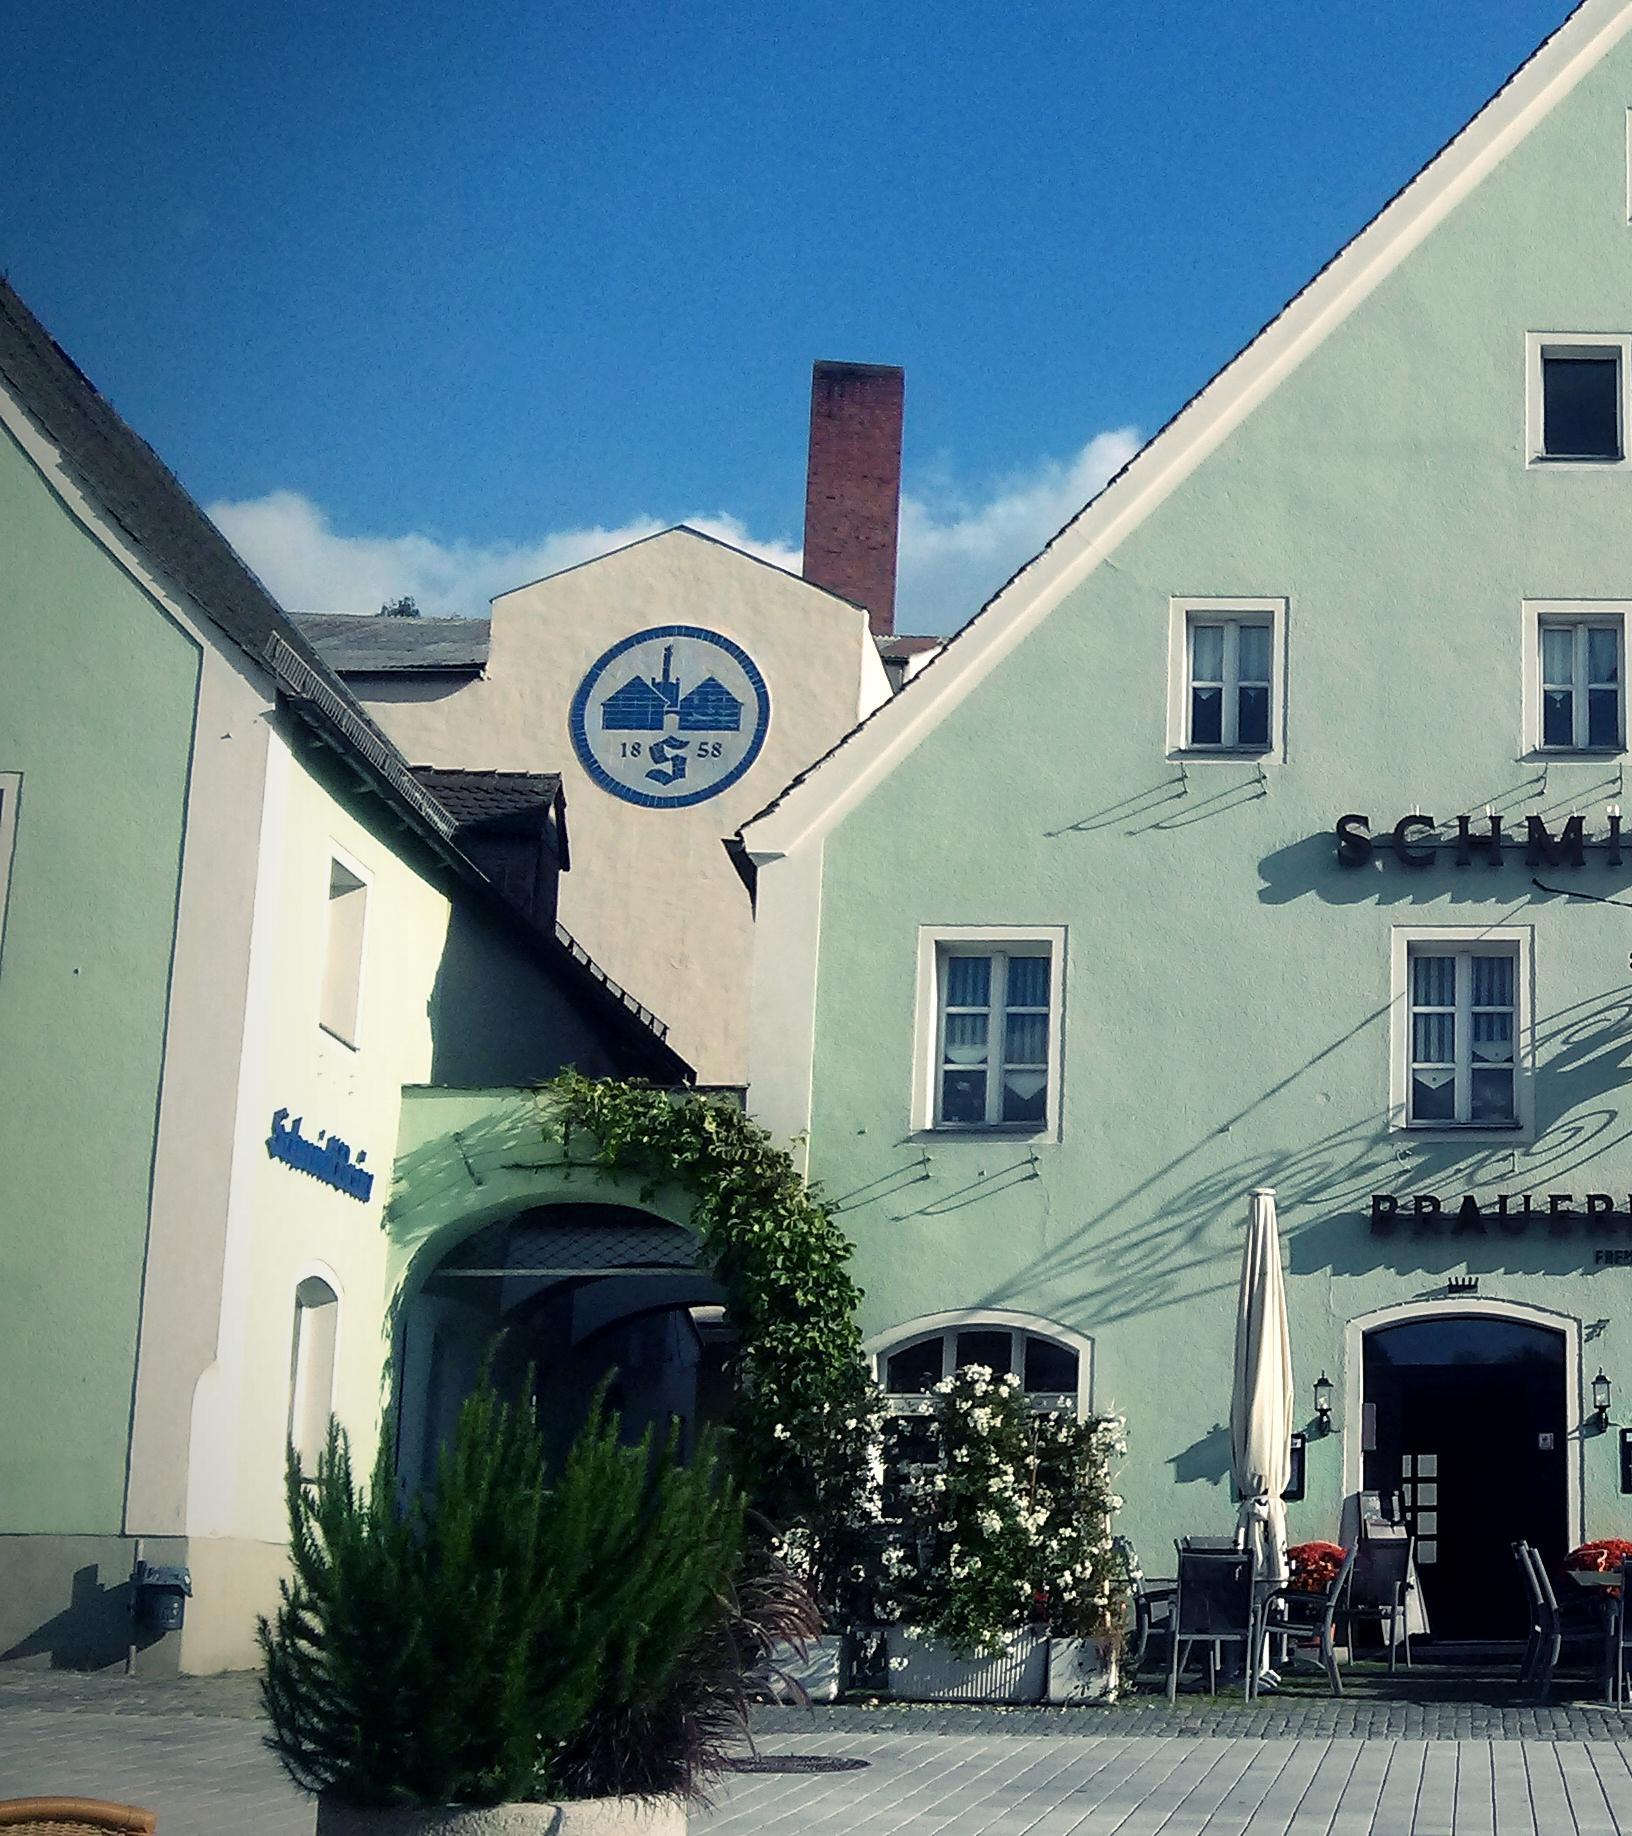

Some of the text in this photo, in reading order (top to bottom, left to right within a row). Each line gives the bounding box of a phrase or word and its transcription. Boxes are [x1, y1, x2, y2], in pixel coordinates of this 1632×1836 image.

[620, 735, 723, 786] 18 S 58
